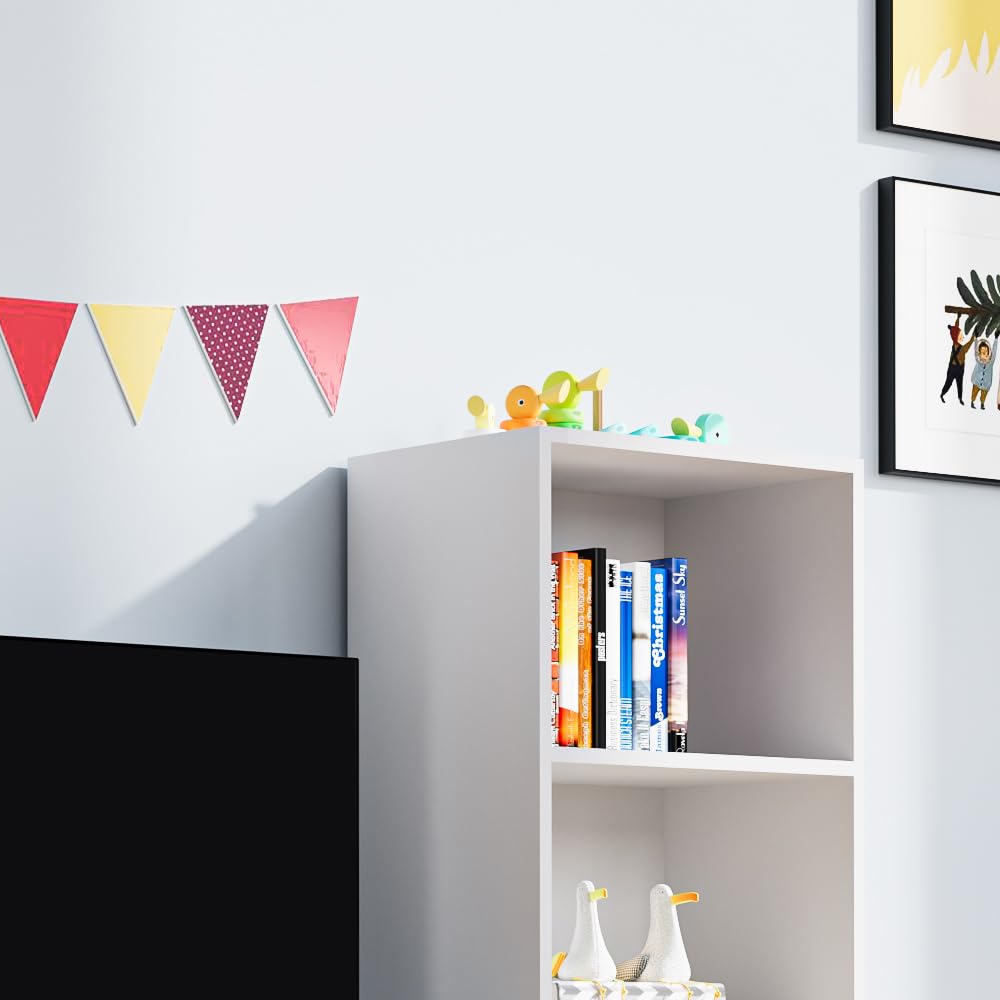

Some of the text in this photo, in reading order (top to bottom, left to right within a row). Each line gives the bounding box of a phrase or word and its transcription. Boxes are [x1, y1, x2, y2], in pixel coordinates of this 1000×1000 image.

[672, 563, 687, 587] Sky
[651, 573, 665, 668] Christmas
[654, 688, 665, 721] Brown
